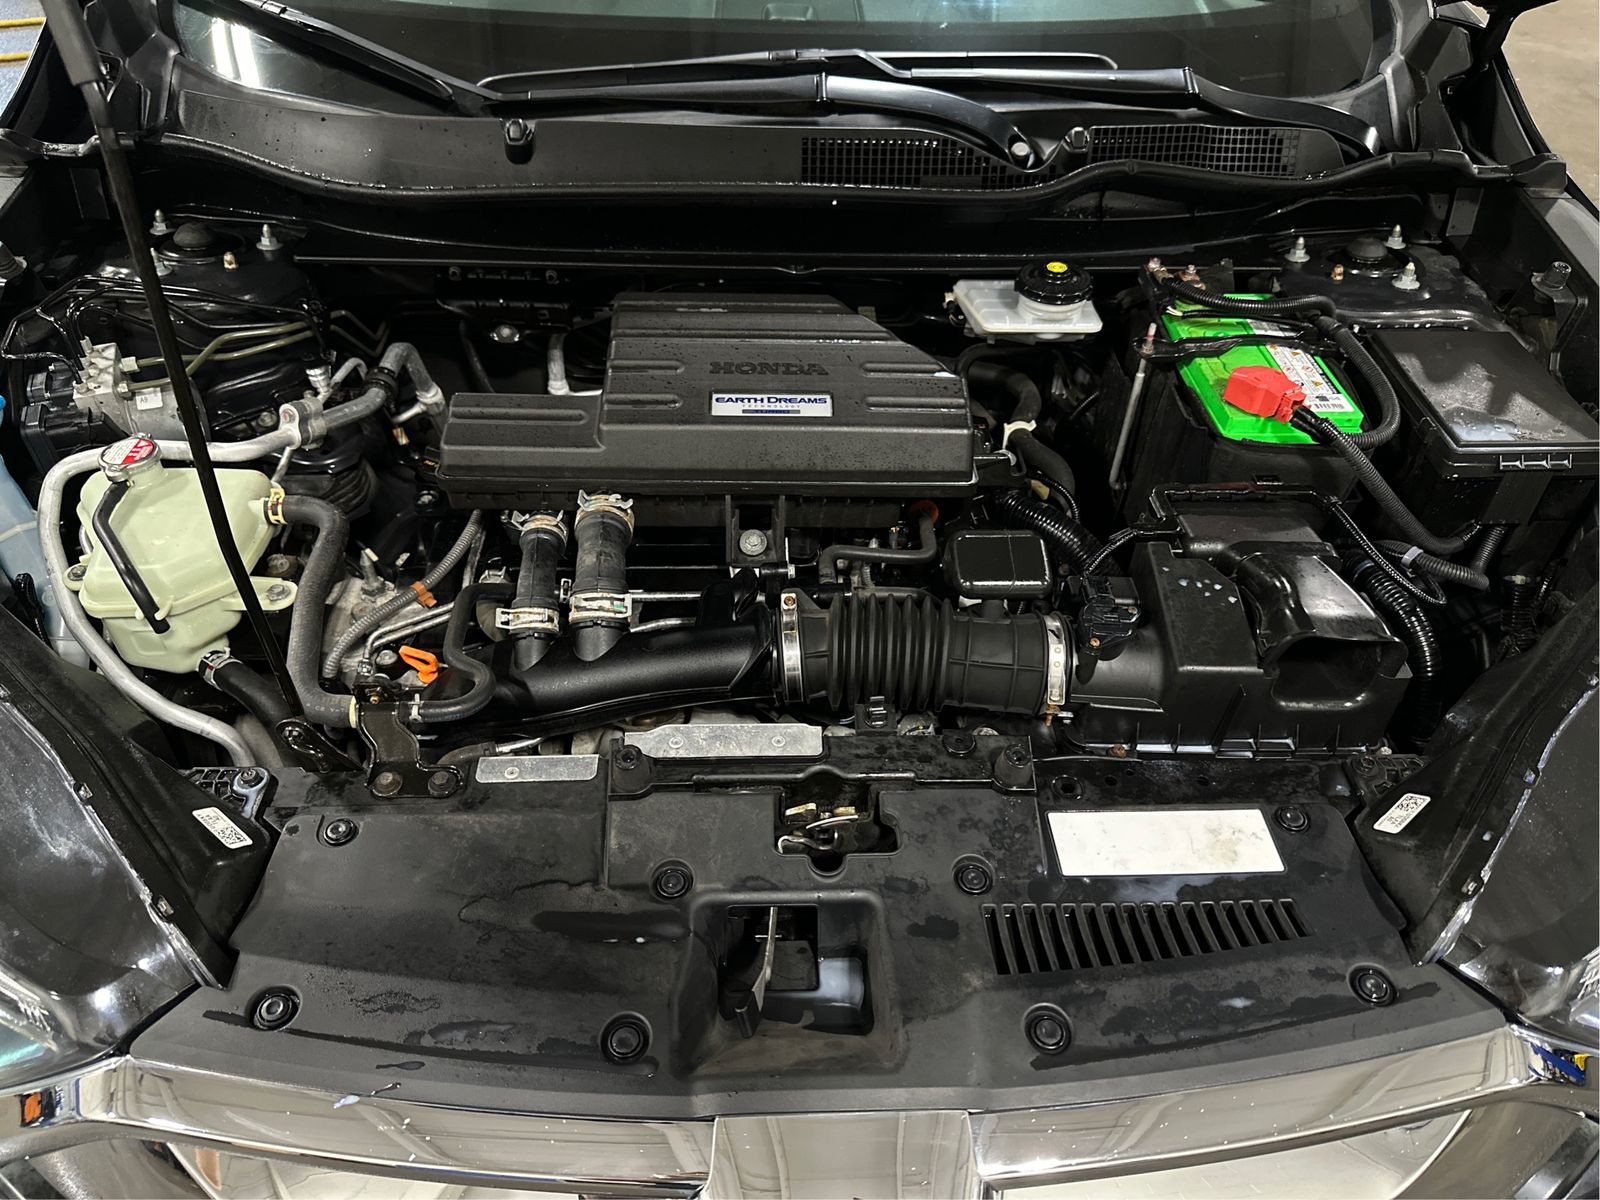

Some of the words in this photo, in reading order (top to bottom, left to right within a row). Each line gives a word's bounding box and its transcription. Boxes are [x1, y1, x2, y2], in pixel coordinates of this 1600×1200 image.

[709, 361, 829, 375] HONDA
[715, 396, 764, 404] EARTH
[767, 396, 827, 404] DREAMS
